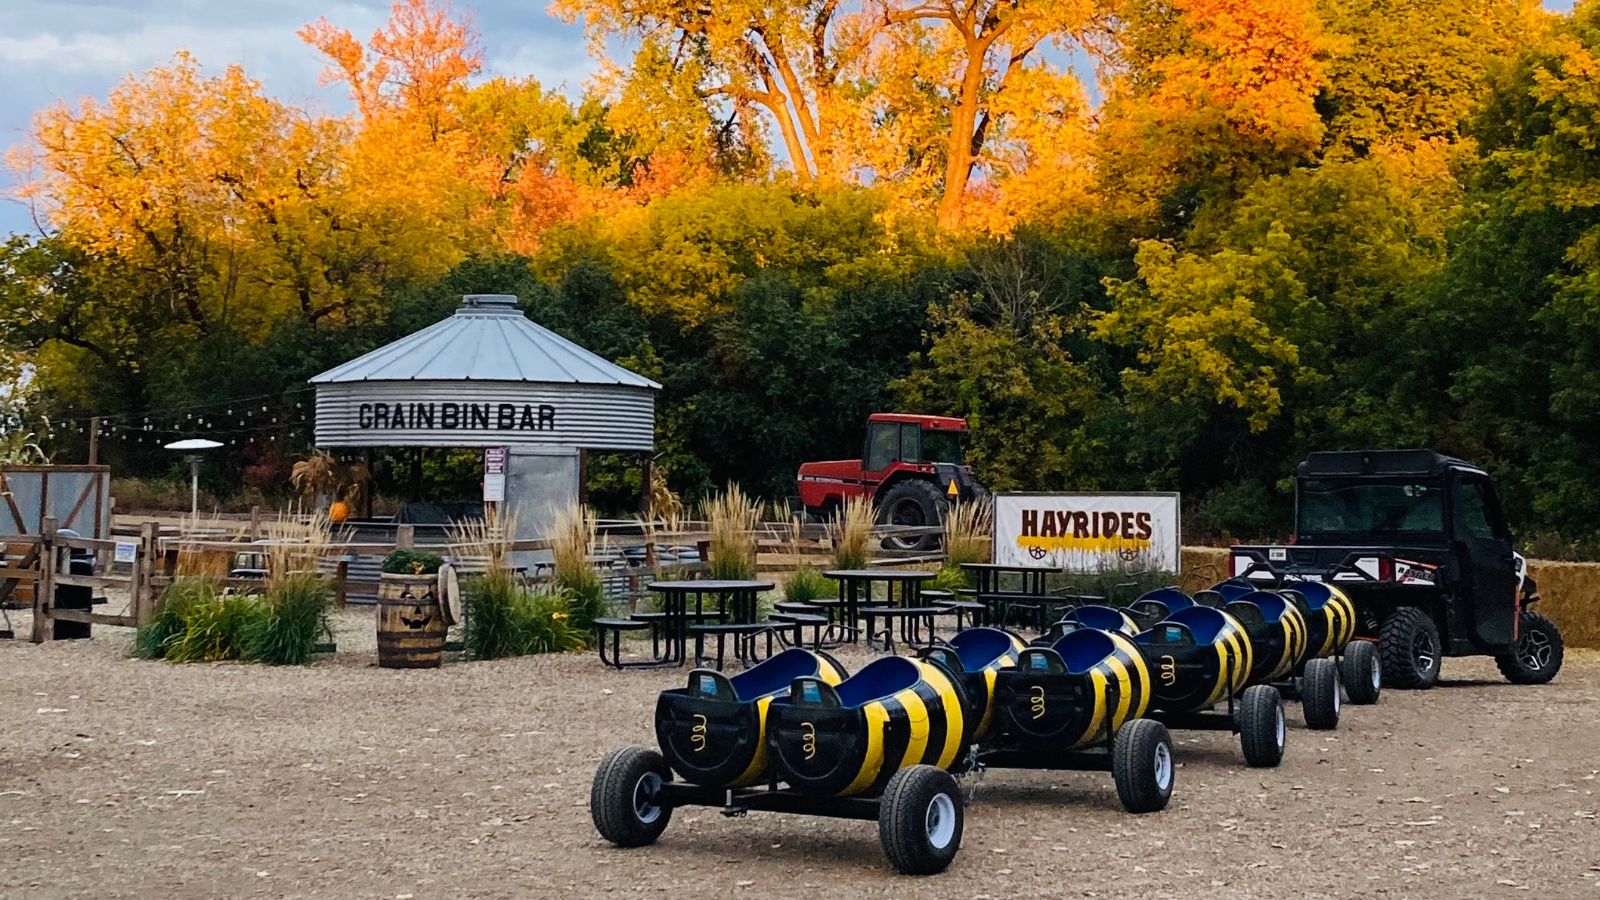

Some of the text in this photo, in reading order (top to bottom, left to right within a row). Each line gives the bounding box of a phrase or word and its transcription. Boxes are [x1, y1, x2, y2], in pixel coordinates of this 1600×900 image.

[359, 403, 555, 430] GRAIN BIN BAR
[1021, 509, 1152, 540] HAYRIDES
